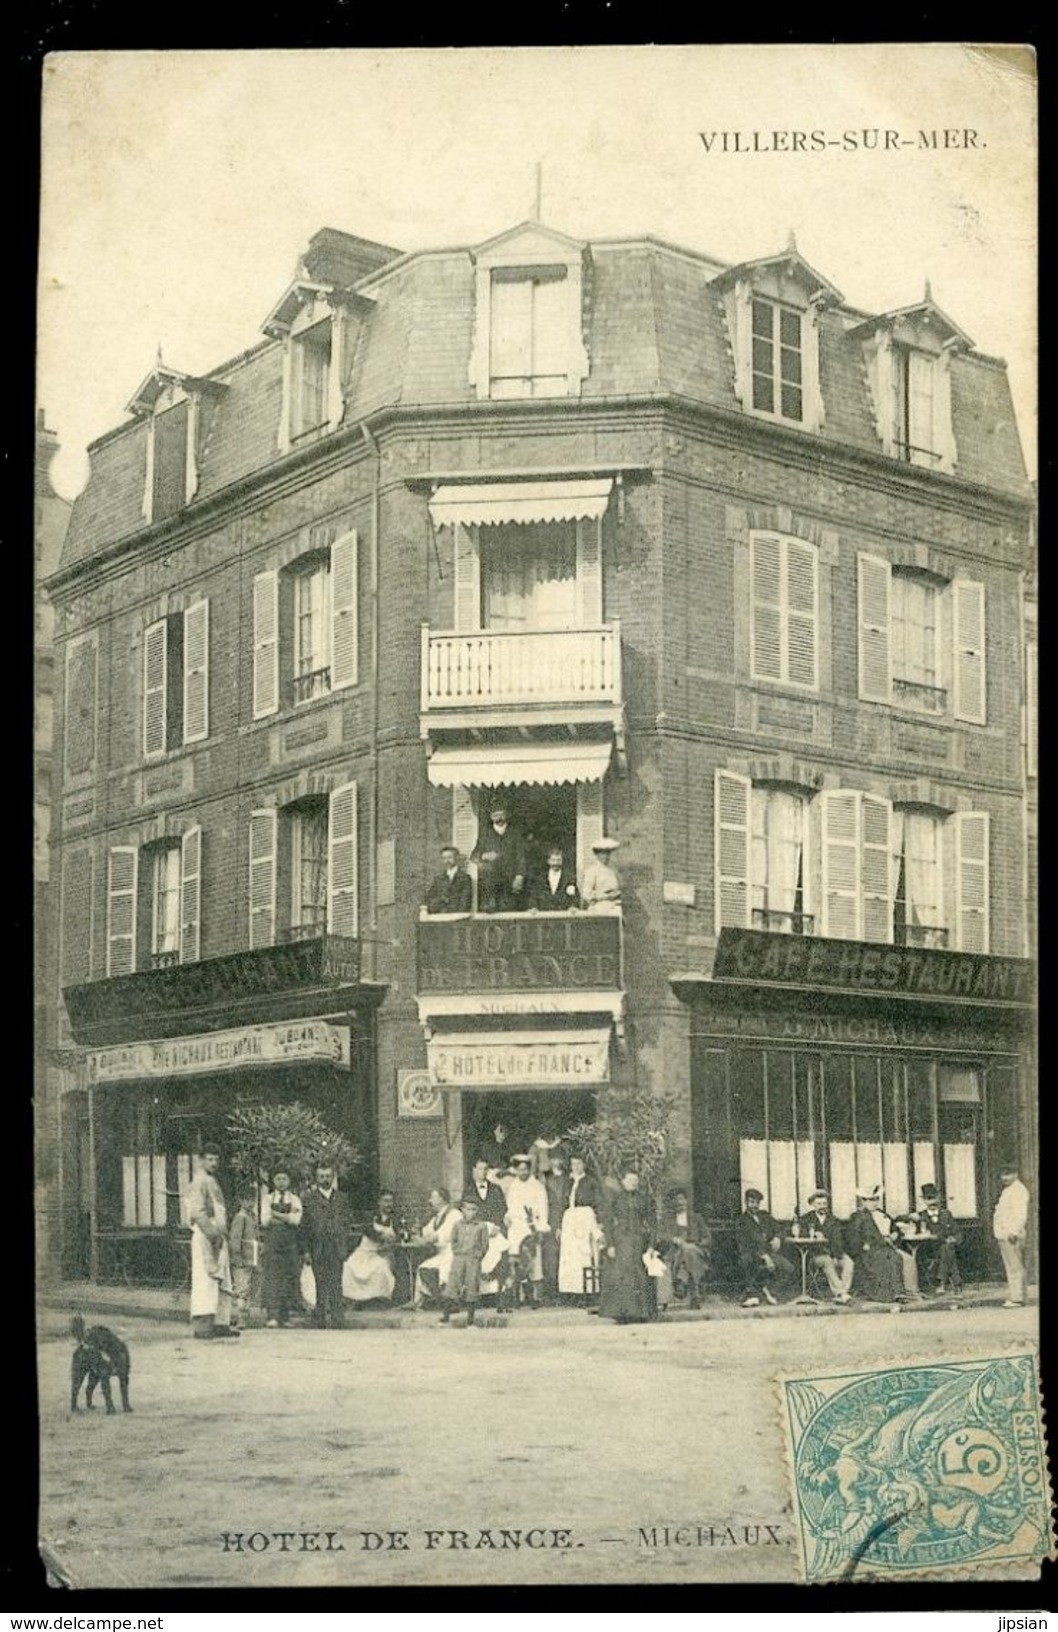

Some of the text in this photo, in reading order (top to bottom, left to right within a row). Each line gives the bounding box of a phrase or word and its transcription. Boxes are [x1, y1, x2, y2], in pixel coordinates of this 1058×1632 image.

[453, 922, 582, 953] HOTEL
[463, 954, 615, 987] FRANCE
[838, 946, 1030, 997] RESTAURANT
[453, 1055, 505, 1076] HOTEL
[527, 1054, 593, 1075] FRANCE
[1015, 1414, 1043, 1502] POSTES
